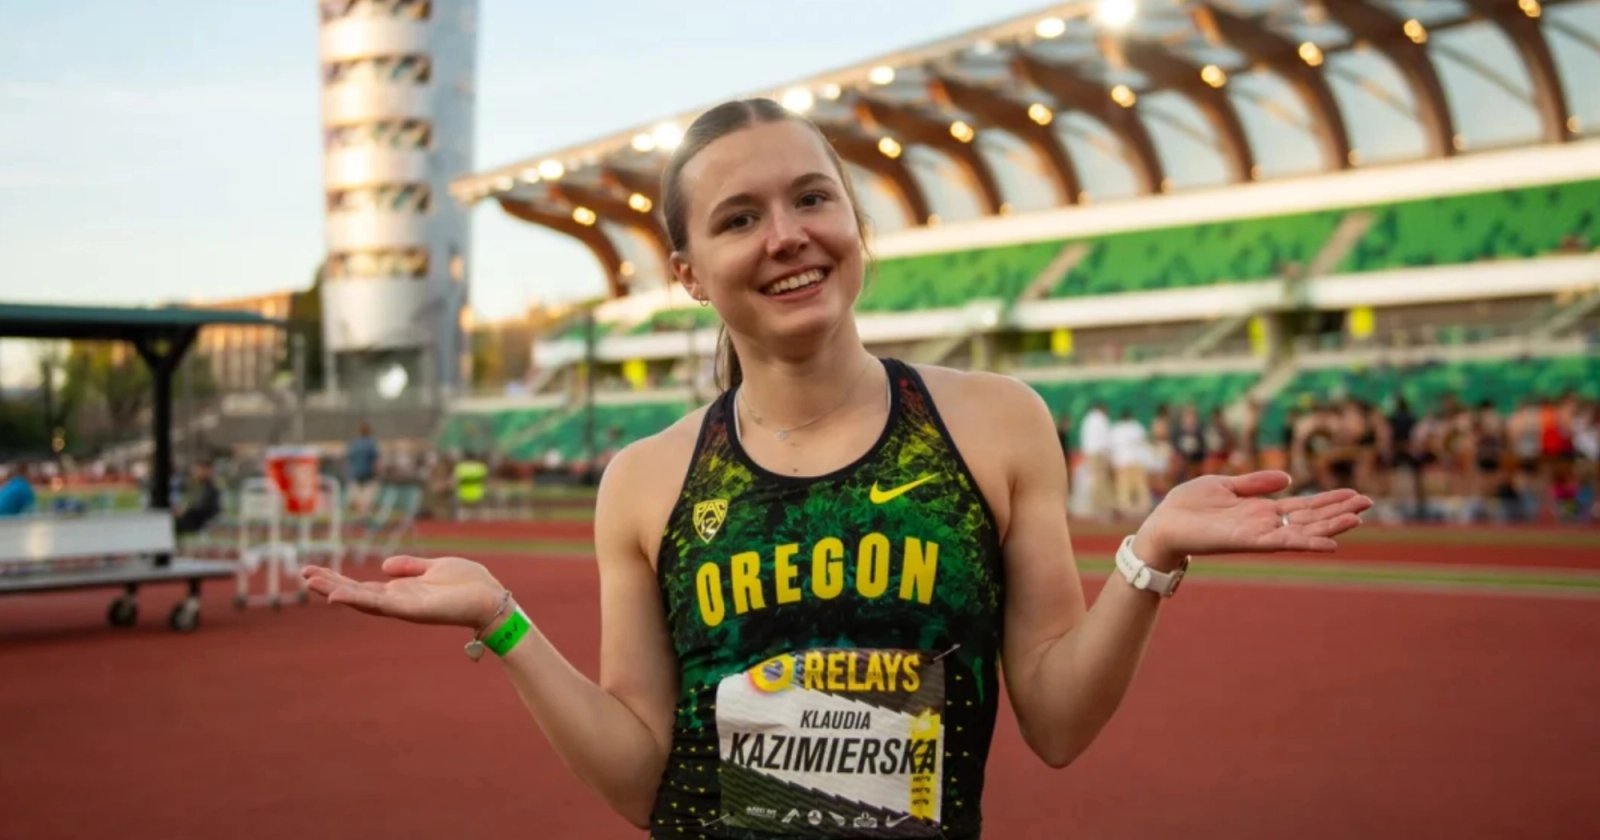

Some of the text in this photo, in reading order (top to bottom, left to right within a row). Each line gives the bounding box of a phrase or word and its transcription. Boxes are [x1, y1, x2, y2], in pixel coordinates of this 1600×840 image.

[695, 500, 727, 524] PAC
[701, 517, 717, 534] 12
[696, 532, 939, 627] OREGON
[804, 651, 920, 692] RELAYS
[800, 710, 871, 730] KLAUDIA
[729, 733, 937, 774] KAZIMIERSKA
